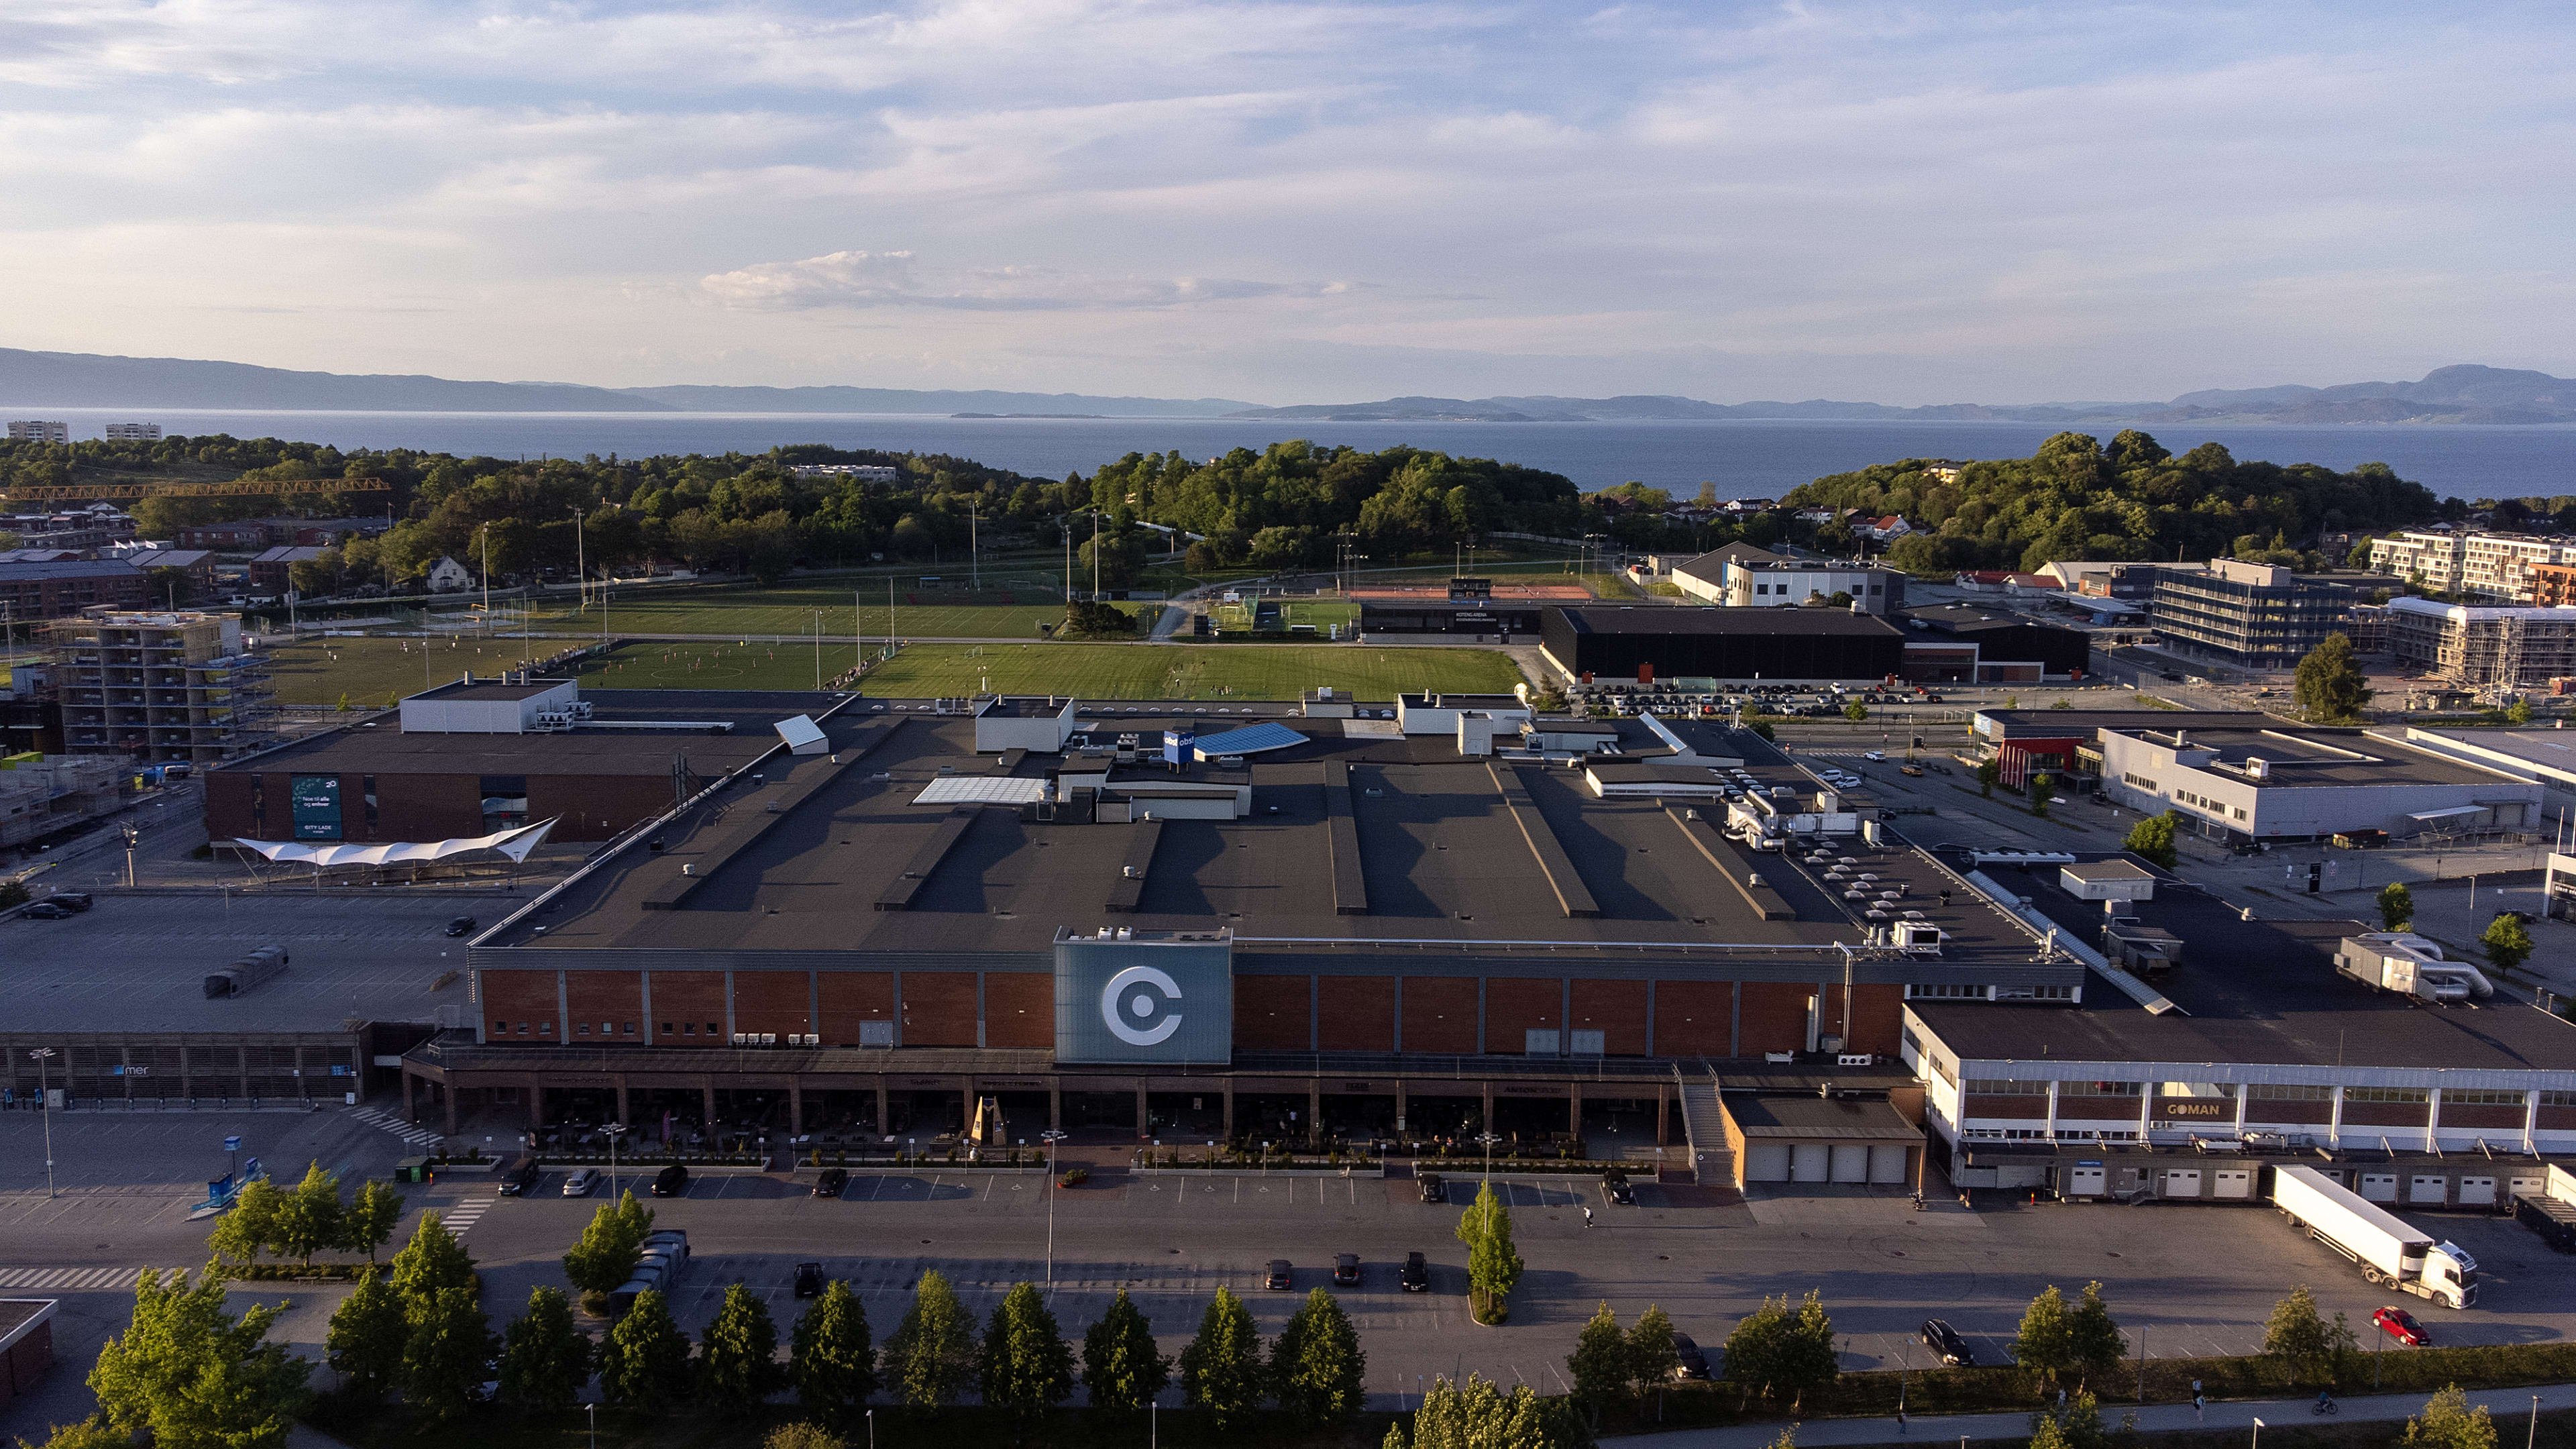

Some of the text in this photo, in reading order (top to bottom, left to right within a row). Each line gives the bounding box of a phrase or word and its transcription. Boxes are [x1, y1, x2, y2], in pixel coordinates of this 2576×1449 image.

[1179, 735, 1194, 747] obs!
[325, 780, 337, 788] 20
[125, 1067, 150, 1075] mer
[2167, 1104, 2220, 1115] GOMAN
